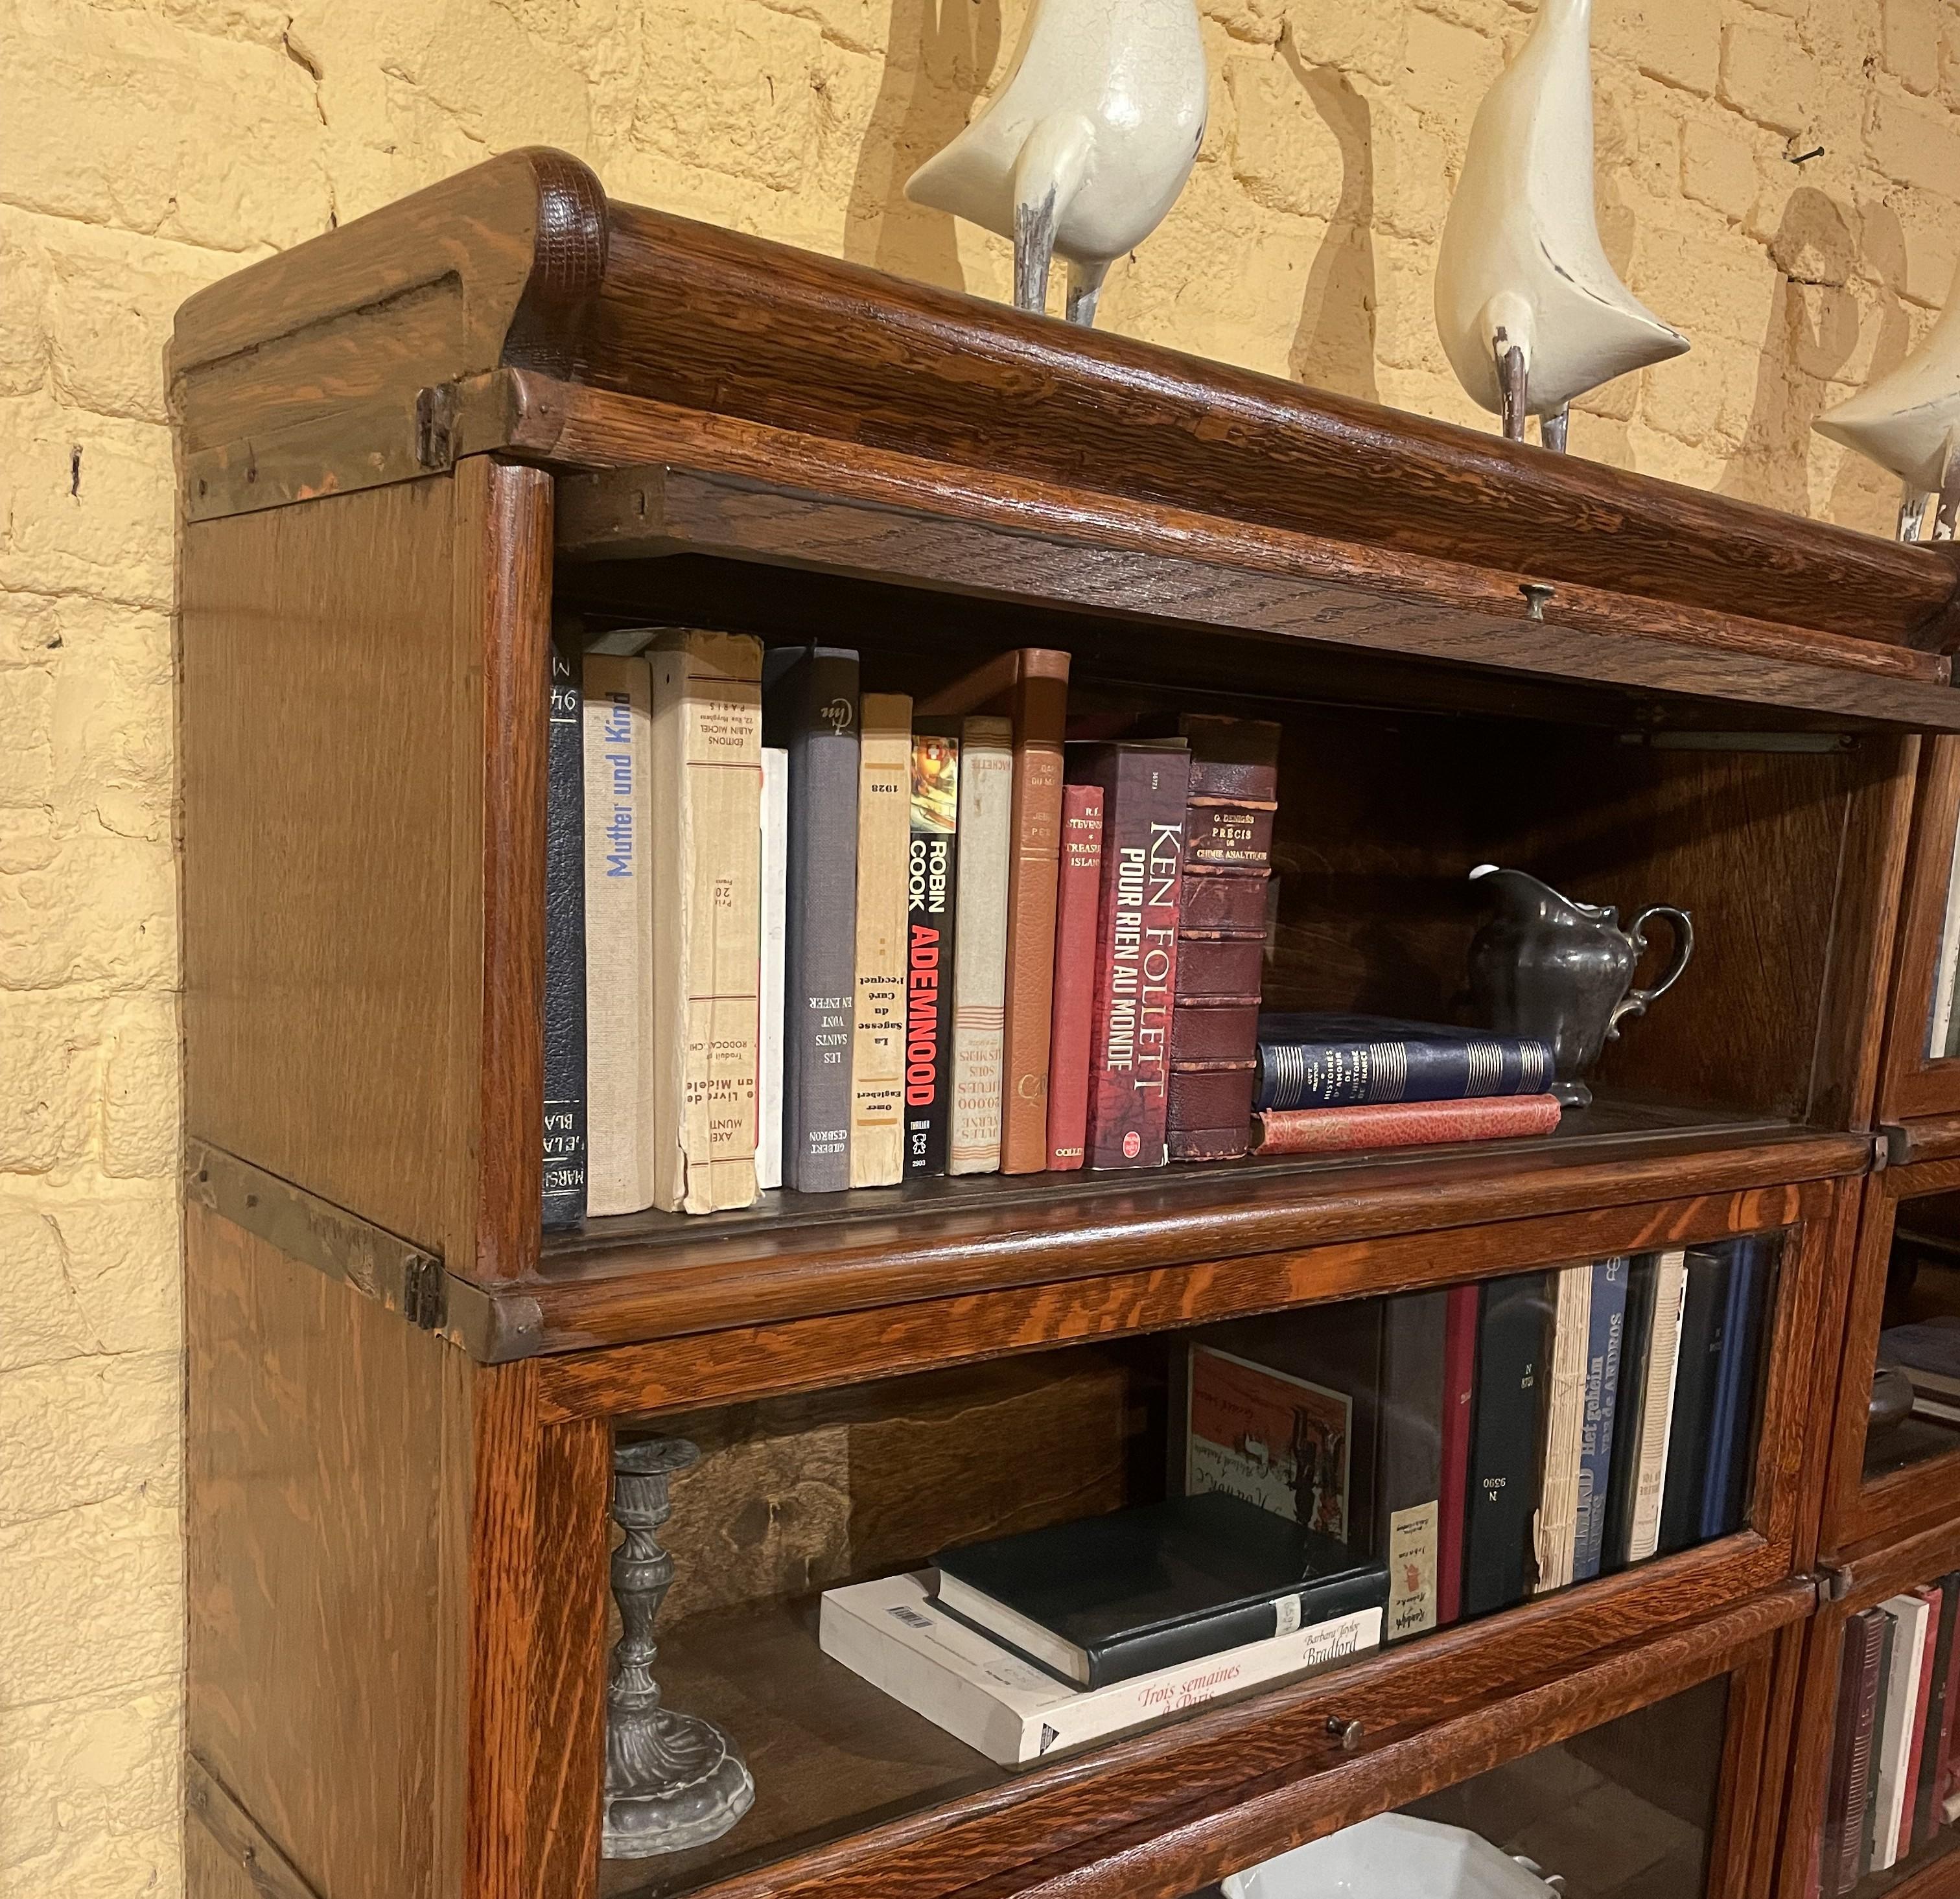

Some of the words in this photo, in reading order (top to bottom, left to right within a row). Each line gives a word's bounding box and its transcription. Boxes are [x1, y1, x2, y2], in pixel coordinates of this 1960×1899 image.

[604, 692, 631, 743] Kind
[709, 702, 745, 712] PARIS
[700, 724, 729, 735] MICHEL
[708, 736, 744, 748] ÉDITIONS
[730, 726, 754, 736] ALBIN
[605, 754, 632, 795] und
[605, 803, 633, 877] Mutter
[909, 841, 927, 912] COOK
[928, 841, 947, 913] ROBIN
[1116, 847, 1146, 907] POUR
[1148, 821, 1183, 908] KEN
[715, 887, 730, 898] 20
[1114, 911, 1143, 961] RIEN
[1112, 966, 1138, 997] AU
[809, 996, 841, 1009] ENFER
[868, 992, 895, 1000] Curé
[821, 1016, 844, 1027] VONT
[874, 1007, 889, 1016] du
[907, 924, 940, 1106] ADEMNOOD
[1133, 926, 1178, 1097] FOLLETT
[858, 1021, 903, 1031] Sagesse
[1106, 998, 1138, 1071] MONDE
[815, 1034, 848, 1046] SAINTS
[874, 1037, 889, 1046] La
[824, 1052, 841, 1064] LES
[1359, 1050, 1368, 1084] FRANCE
[1323, 1049, 1334, 1101] HISTOIRES
[1333, 1051, 1343, 1098] D'AMOUR
[1344, 1069, 1351, 1082] DE
[1349, 1050, 1360, 1099] L'HISTOIRE
[857, 1091, 902, 1099] Englebert
[809, 1130, 848, 1141] CESBRON
[962, 1118, 998, 1128] VERNE
[962, 1128, 998, 1139] JULES
[810, 1143, 845, 1154] GILBERT
[1602, 1312, 1623, 1392] ANDROS
[1525, 1363, 1532, 1376] N
[1583, 1357, 1604, 1421] geheim
[1601, 1395, 1614, 1417] de
[1581, 1422, 1599, 1456] Het
[1489, 1491, 1497, 1502] N
[1303, 1629, 1338, 1647] Barbara
[1338, 1621, 1362, 1638] Taylor
[1303, 1631, 1358, 1666] Bradford
[1138, 1685, 1176, 1708] Trois
[1179, 1664, 1241, 1695] semaines
[1163, 1701, 1171, 1716] à
[1174, 1689, 1214, 1709] Paris
